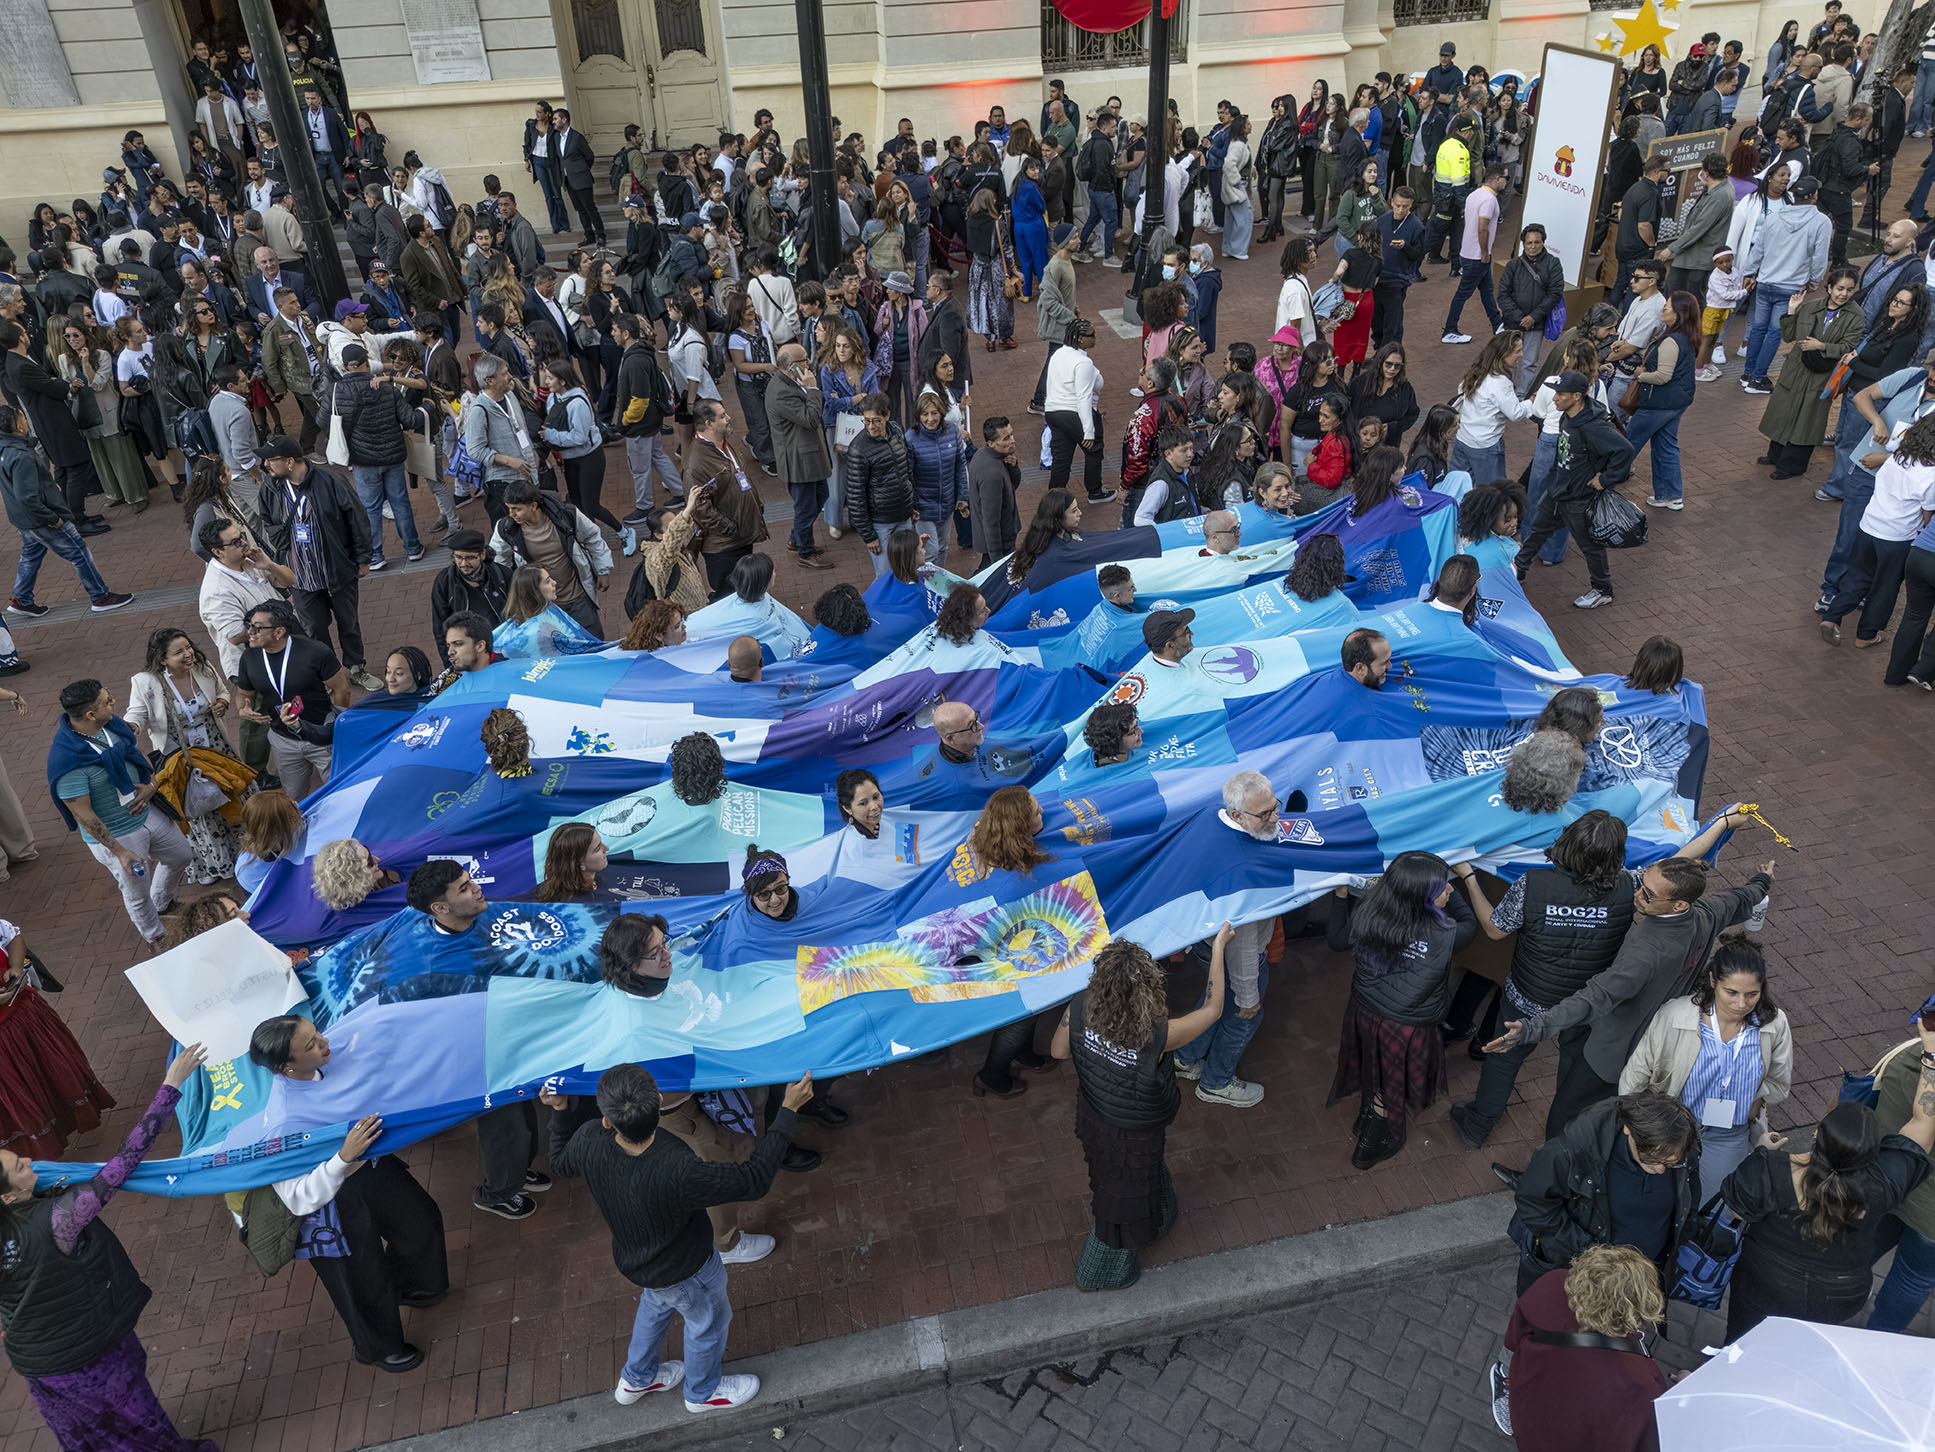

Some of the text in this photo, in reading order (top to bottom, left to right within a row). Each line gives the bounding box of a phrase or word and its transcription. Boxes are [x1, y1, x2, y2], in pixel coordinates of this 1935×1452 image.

[1660, 148, 1673, 157] SOY
[1693, 141, 1716, 152] FELIZ
[1673, 152, 1700, 163] CUANDO
[1288, 598, 1302, 613] HERO
[1471, 750, 1495, 774] CR
[1317, 767, 1340, 810] YALS
[1363, 768, 1376, 784] CITY
[721, 790, 732, 833] PRAYING
[731, 792, 743, 836] PELICAN
[743, 791, 754, 838] MISSIONS
[1546, 904, 1608, 919] BOG25
[538, 911, 564, 938] DOGS
[220, 1062, 231, 1090] BRO
